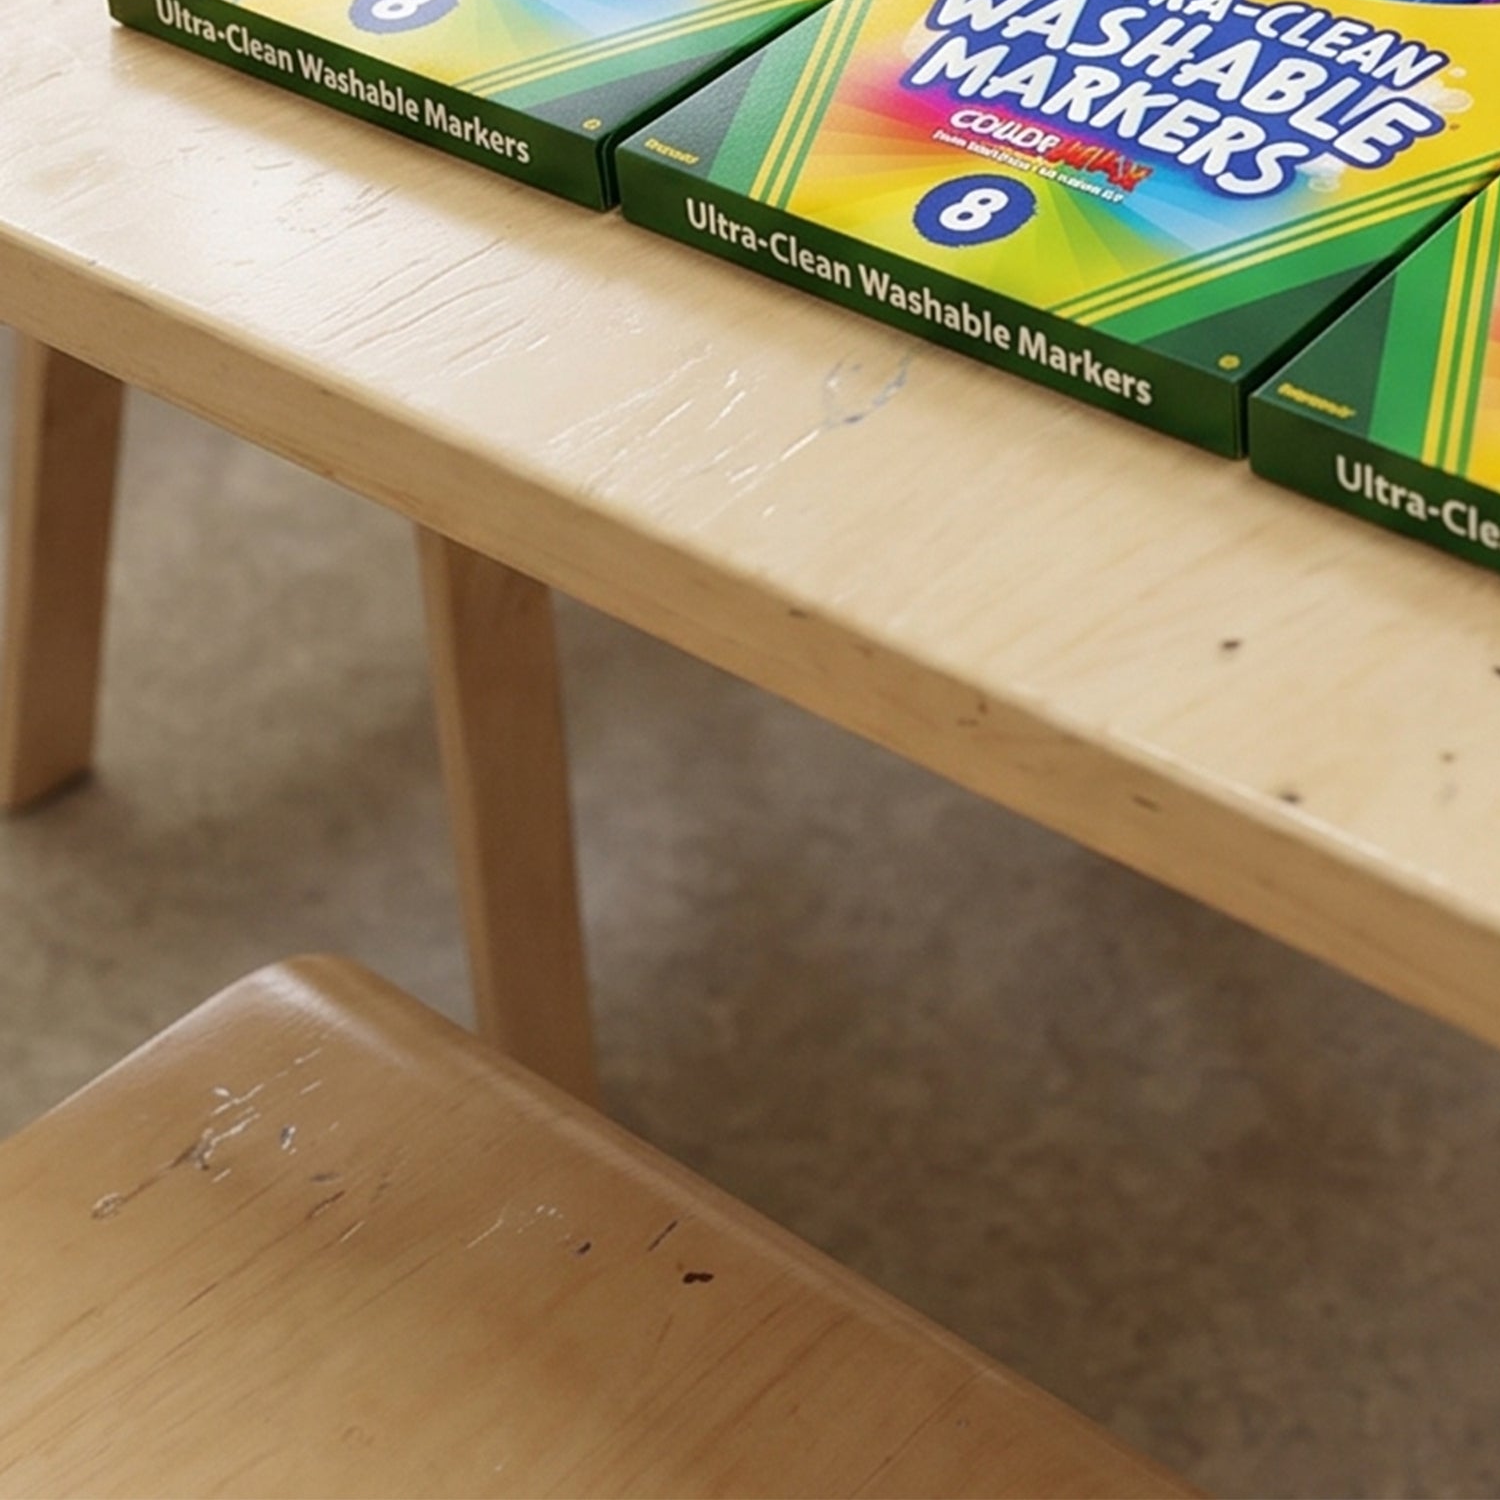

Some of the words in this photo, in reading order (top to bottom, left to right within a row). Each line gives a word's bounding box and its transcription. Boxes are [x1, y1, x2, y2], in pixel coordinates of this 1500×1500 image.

[296, 49, 419, 122] Washable
[424, 98, 531, 165] Markers
[912, 37, 1309, 195] MARKERS
[939, 187, 1009, 232] 8
[686, 197, 853, 290] Ultra-Clean
[858, 263, 1010, 350] Washable
[1017, 326, 1153, 407] Markers
